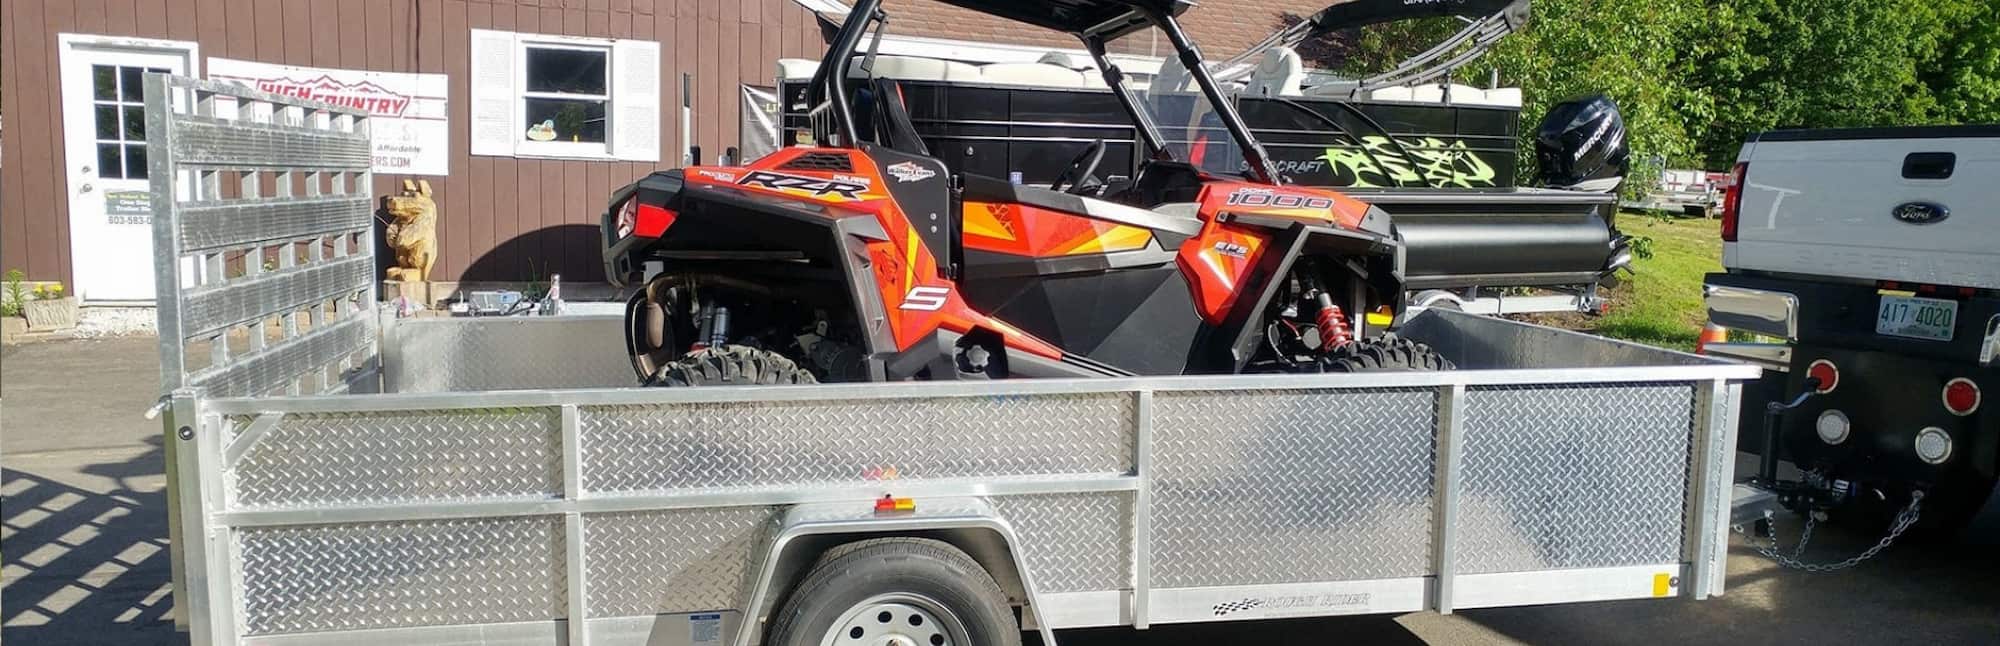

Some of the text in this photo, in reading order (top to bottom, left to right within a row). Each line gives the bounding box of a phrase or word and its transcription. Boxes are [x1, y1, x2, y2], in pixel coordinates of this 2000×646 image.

[1574, 112, 1613, 161] MERCURY
[735, 170, 869, 201] RZR
[1227, 191, 1335, 209] 1000
[1901, 204, 1932, 219] Ford
[898, 285, 952, 311] S
[1881, 303, 1953, 328] 417 4020
